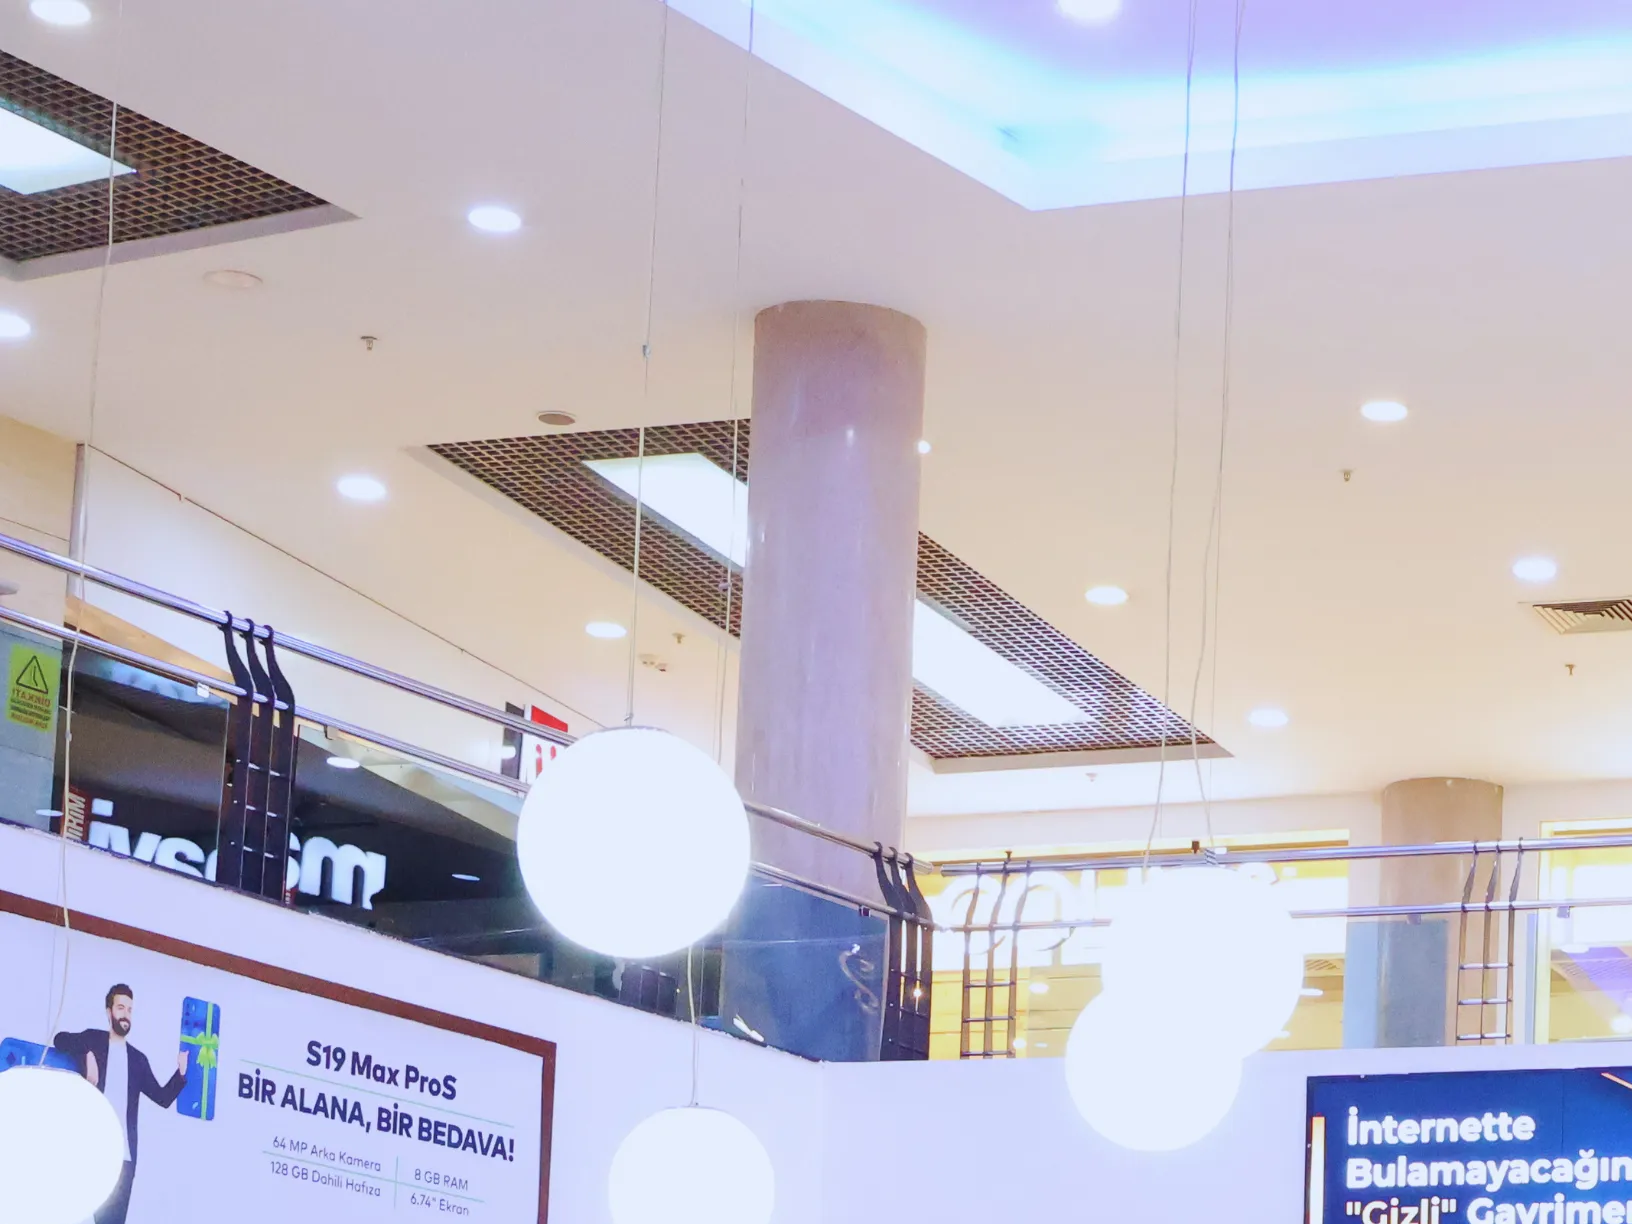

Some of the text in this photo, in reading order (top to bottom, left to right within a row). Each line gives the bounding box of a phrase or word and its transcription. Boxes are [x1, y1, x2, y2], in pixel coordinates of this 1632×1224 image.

[306, 1040, 457, 1100] S19 Max ProS
[238, 1068, 515, 1162] BİR ALANA, BİR BEDAVA!
[1347, 1106, 1536, 1146] İnternette
[273, 1136, 382, 1172] 64 MP Arka Kamera
[270, 1161, 289, 1177] 128
[292, 1166, 309, 1180] GB
[312, 1170, 343, 1188] Dahili
[414, 1168, 468, 1191] 8 GB RAM
[439, 1199, 470, 1216] Ekran
